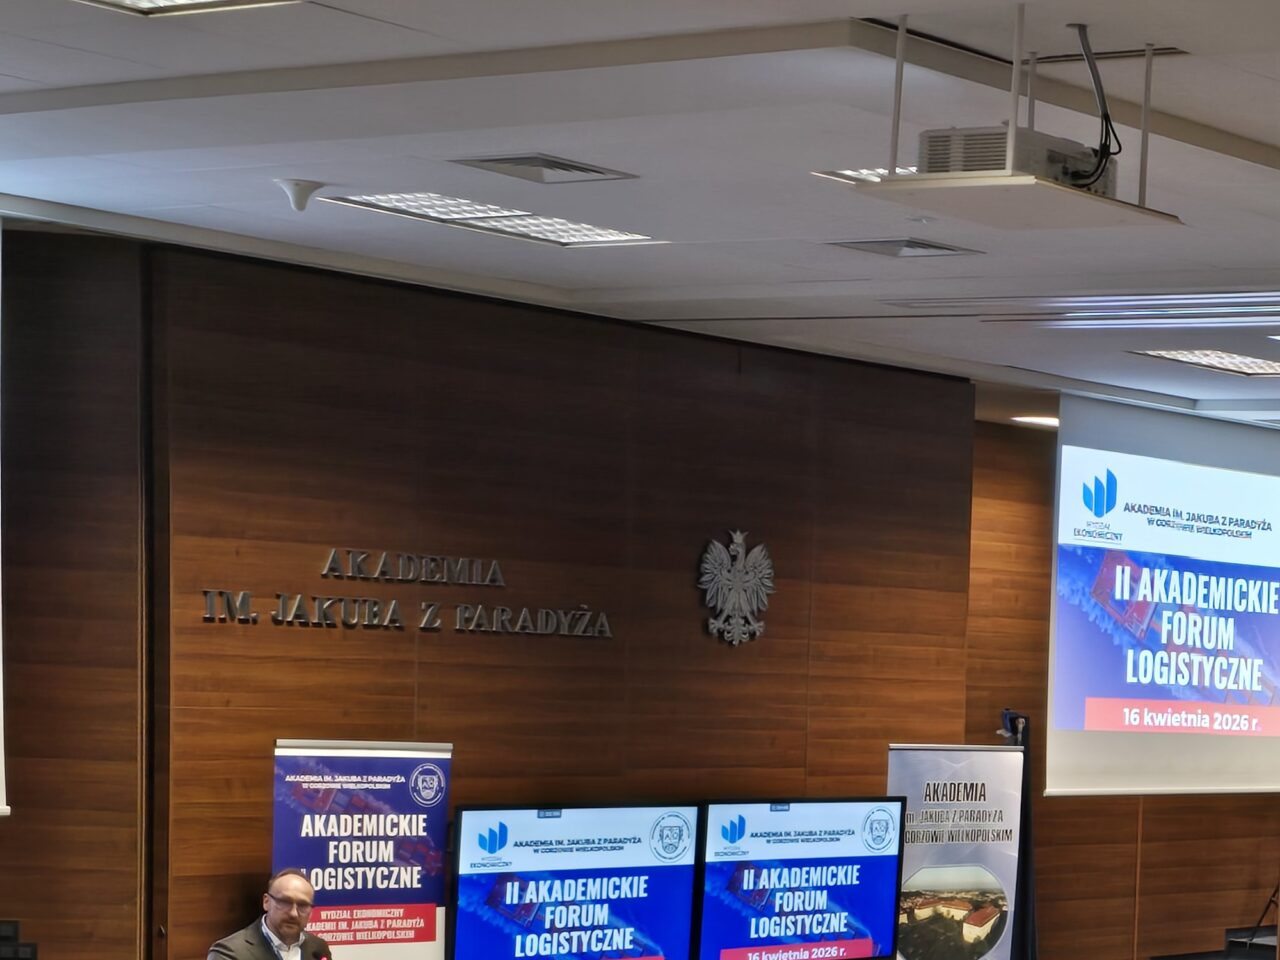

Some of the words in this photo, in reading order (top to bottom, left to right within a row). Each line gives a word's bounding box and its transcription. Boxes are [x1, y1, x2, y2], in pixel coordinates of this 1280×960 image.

[1123, 502, 1170, 517] AKADEMIA
[1185, 511, 1220, 525] JAKUBA
[1221, 516, 1228, 525] Z
[320, 548, 505, 586] AKADEMIA
[1114, 565, 1131, 601] II
[1137, 567, 1280, 614] AKADEMICKIE
[203, 589, 258, 625] IM.
[271, 592, 403, 631] JAKUBA
[419, 601, 442, 632] Z
[455, 604, 613, 638] PARADYŻA
[1161, 610, 1234, 650] FORUM
[1126, 650, 1263, 691] LOGISTYCZNE
[1123, 708, 1139, 726] 16
[1143, 708, 1209, 728] kwietnia
[1213, 712, 1249, 731] 2026
[1251, 717, 1262, 732] r.
[924, 782, 987, 802] AKADEMIA
[301, 814, 427, 837] AKADEMICKIE
[328, 840, 394, 863] FORUM
[301, 866, 422, 890] OGISTYCZNE
[505, 881, 519, 904] II
[525, 876, 648, 904] AKADEMICKIE
[743, 869, 755, 890] II
[759, 865, 860, 889] AKADEMICKIE
[775, 890, 827, 912] FORUM
[544, 904, 609, 929] FORUM
[750, 912, 848, 938] LOGISTYCZNE
[515, 928, 634, 958] LOGISTYCZNE
[812, 946, 838, 959] 2026
[840, 947, 846, 957] r.
